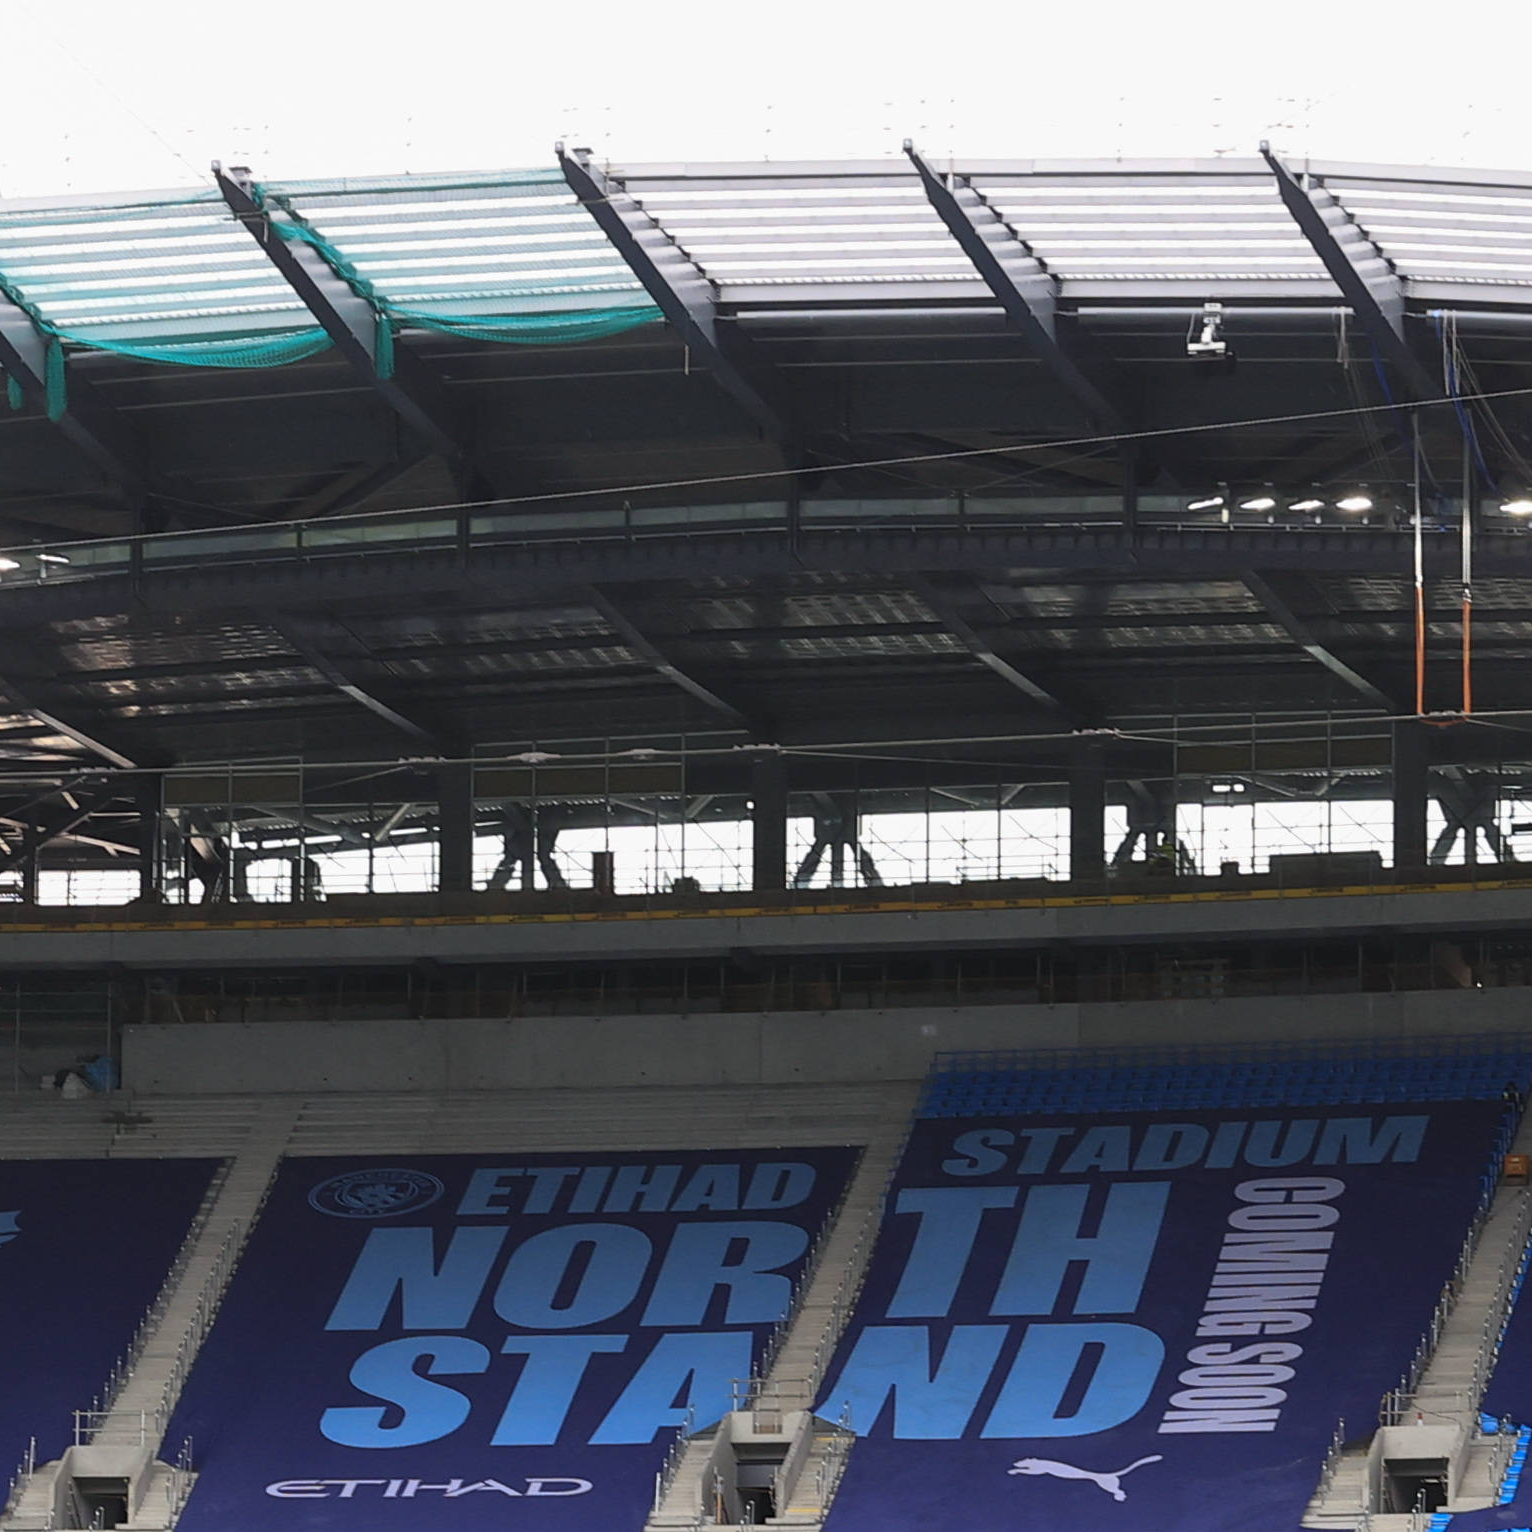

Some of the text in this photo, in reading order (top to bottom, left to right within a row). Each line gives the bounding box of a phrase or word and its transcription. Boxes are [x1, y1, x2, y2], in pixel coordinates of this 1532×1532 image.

[456, 1115, 1430, 1215] ETIHAD STADIUM
[1157, 1176, 1346, 1434] COMING SOON
[266, 1477, 594, 1498] ETIHAD
